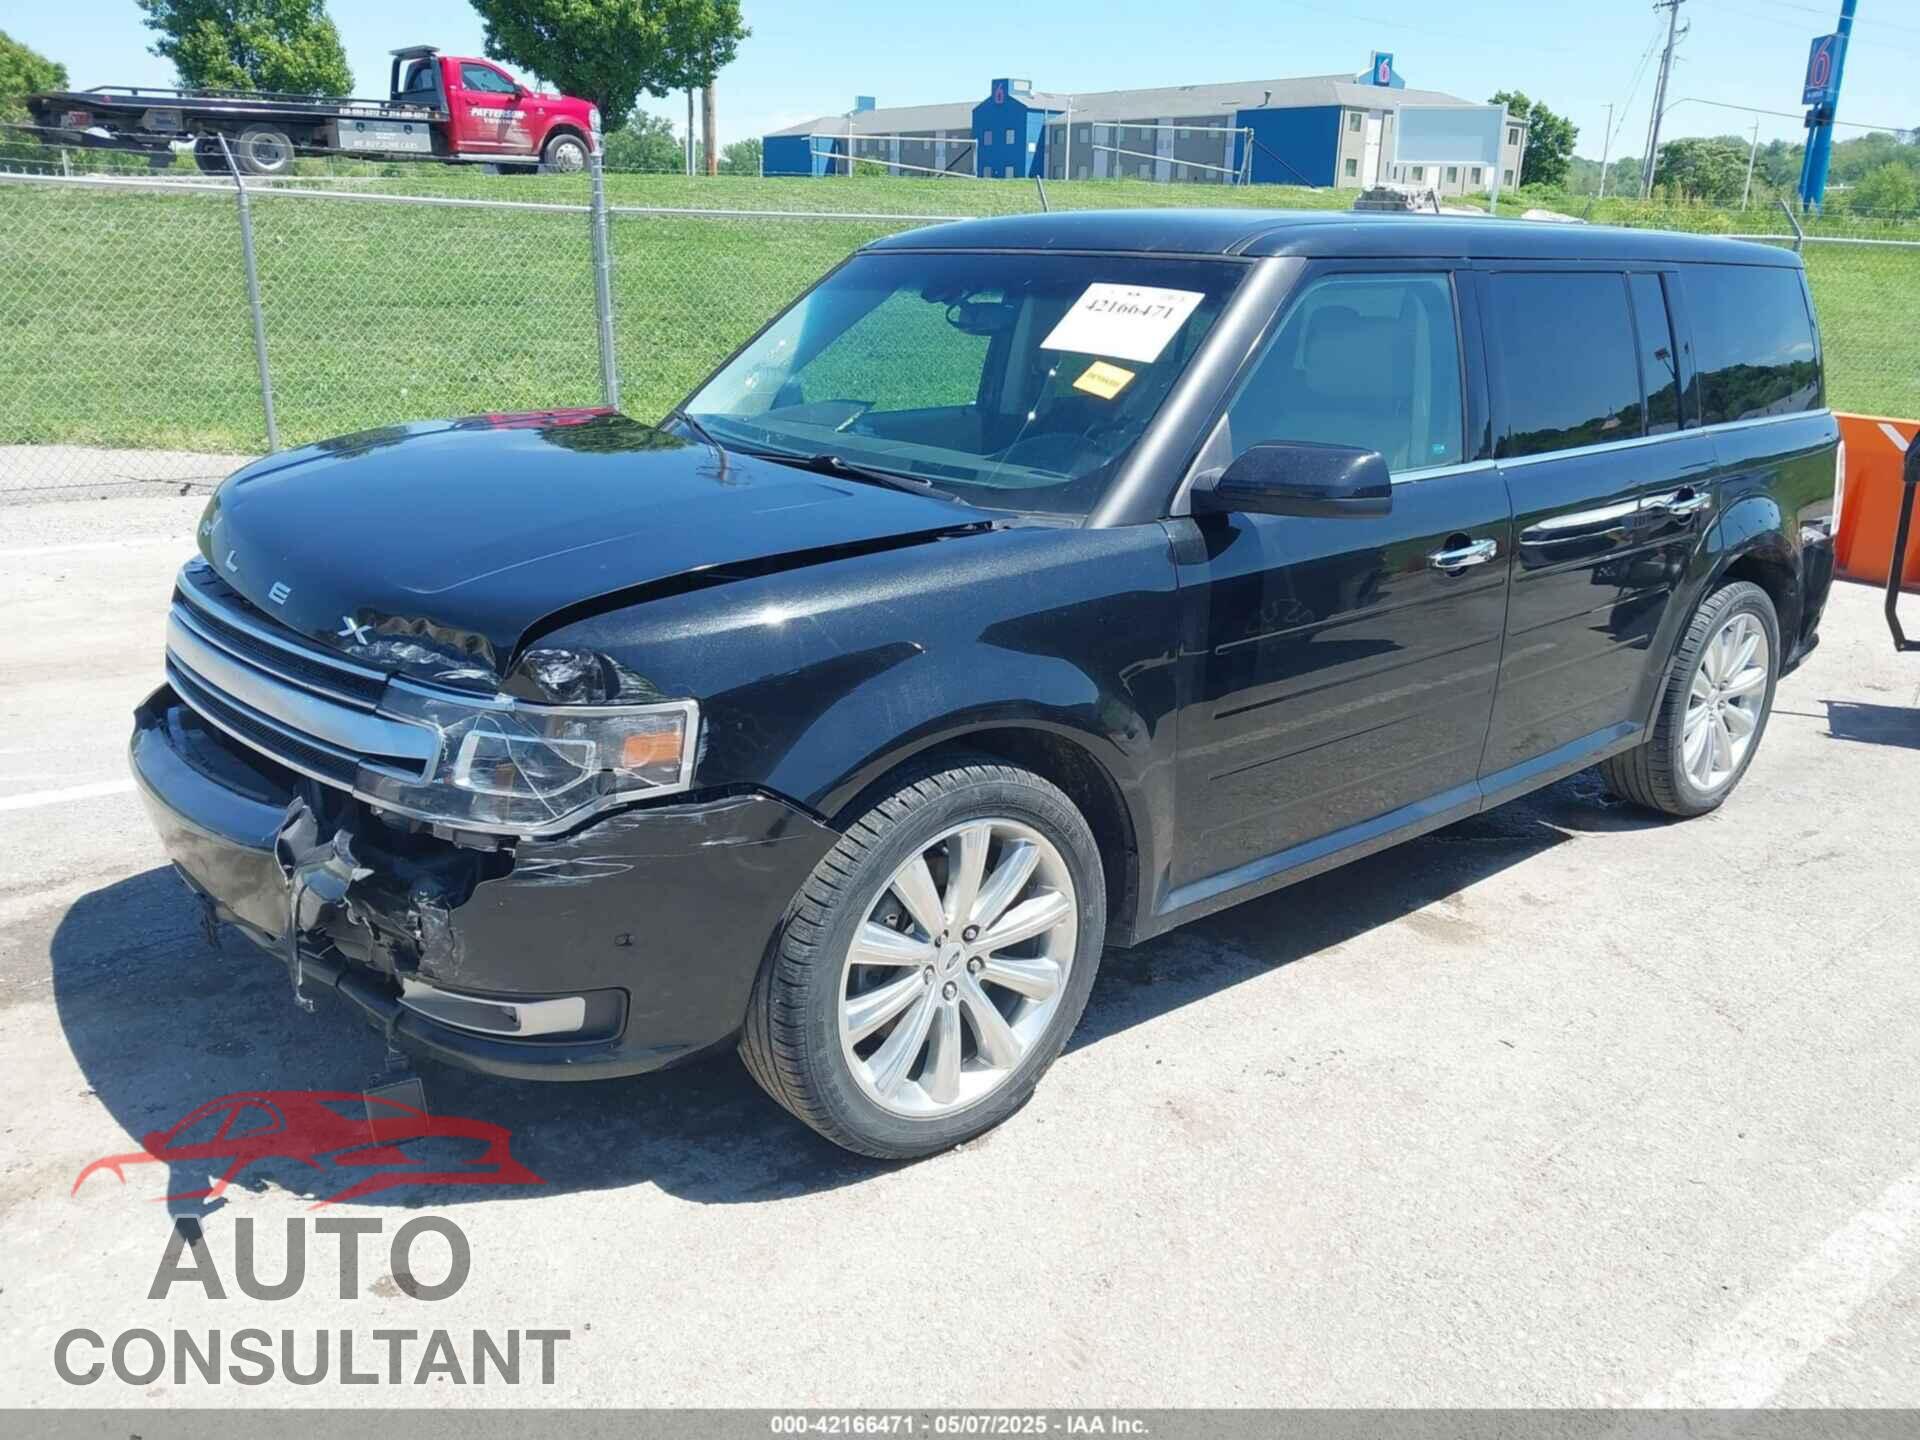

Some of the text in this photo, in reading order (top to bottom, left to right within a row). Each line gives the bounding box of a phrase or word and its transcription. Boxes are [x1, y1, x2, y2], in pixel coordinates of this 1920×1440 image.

[1379, 58, 1390, 82] 6
[1811, 36, 1832, 88] 6
[995, 83, 1004, 104] 6
[1085, 299, 1175, 320] 42166471
